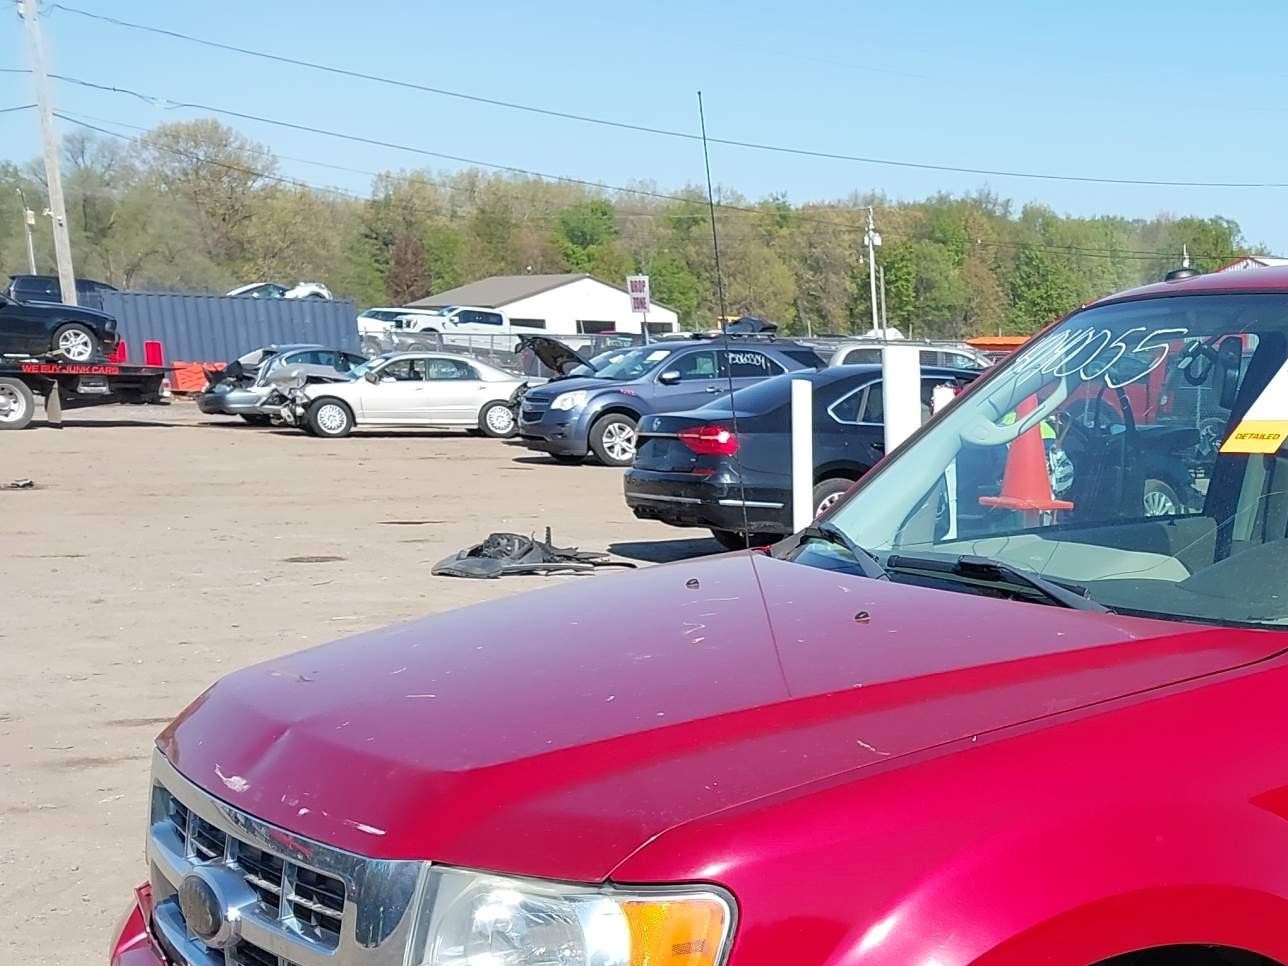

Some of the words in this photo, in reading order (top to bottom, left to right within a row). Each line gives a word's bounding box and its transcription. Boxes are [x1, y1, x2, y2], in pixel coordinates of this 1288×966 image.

[22, 364, 39, 374] WE
[40, 364, 61, 374] BUY
[62, 364, 90, 375] JUNK
[1235, 432, 1281, 440] DETAILED
